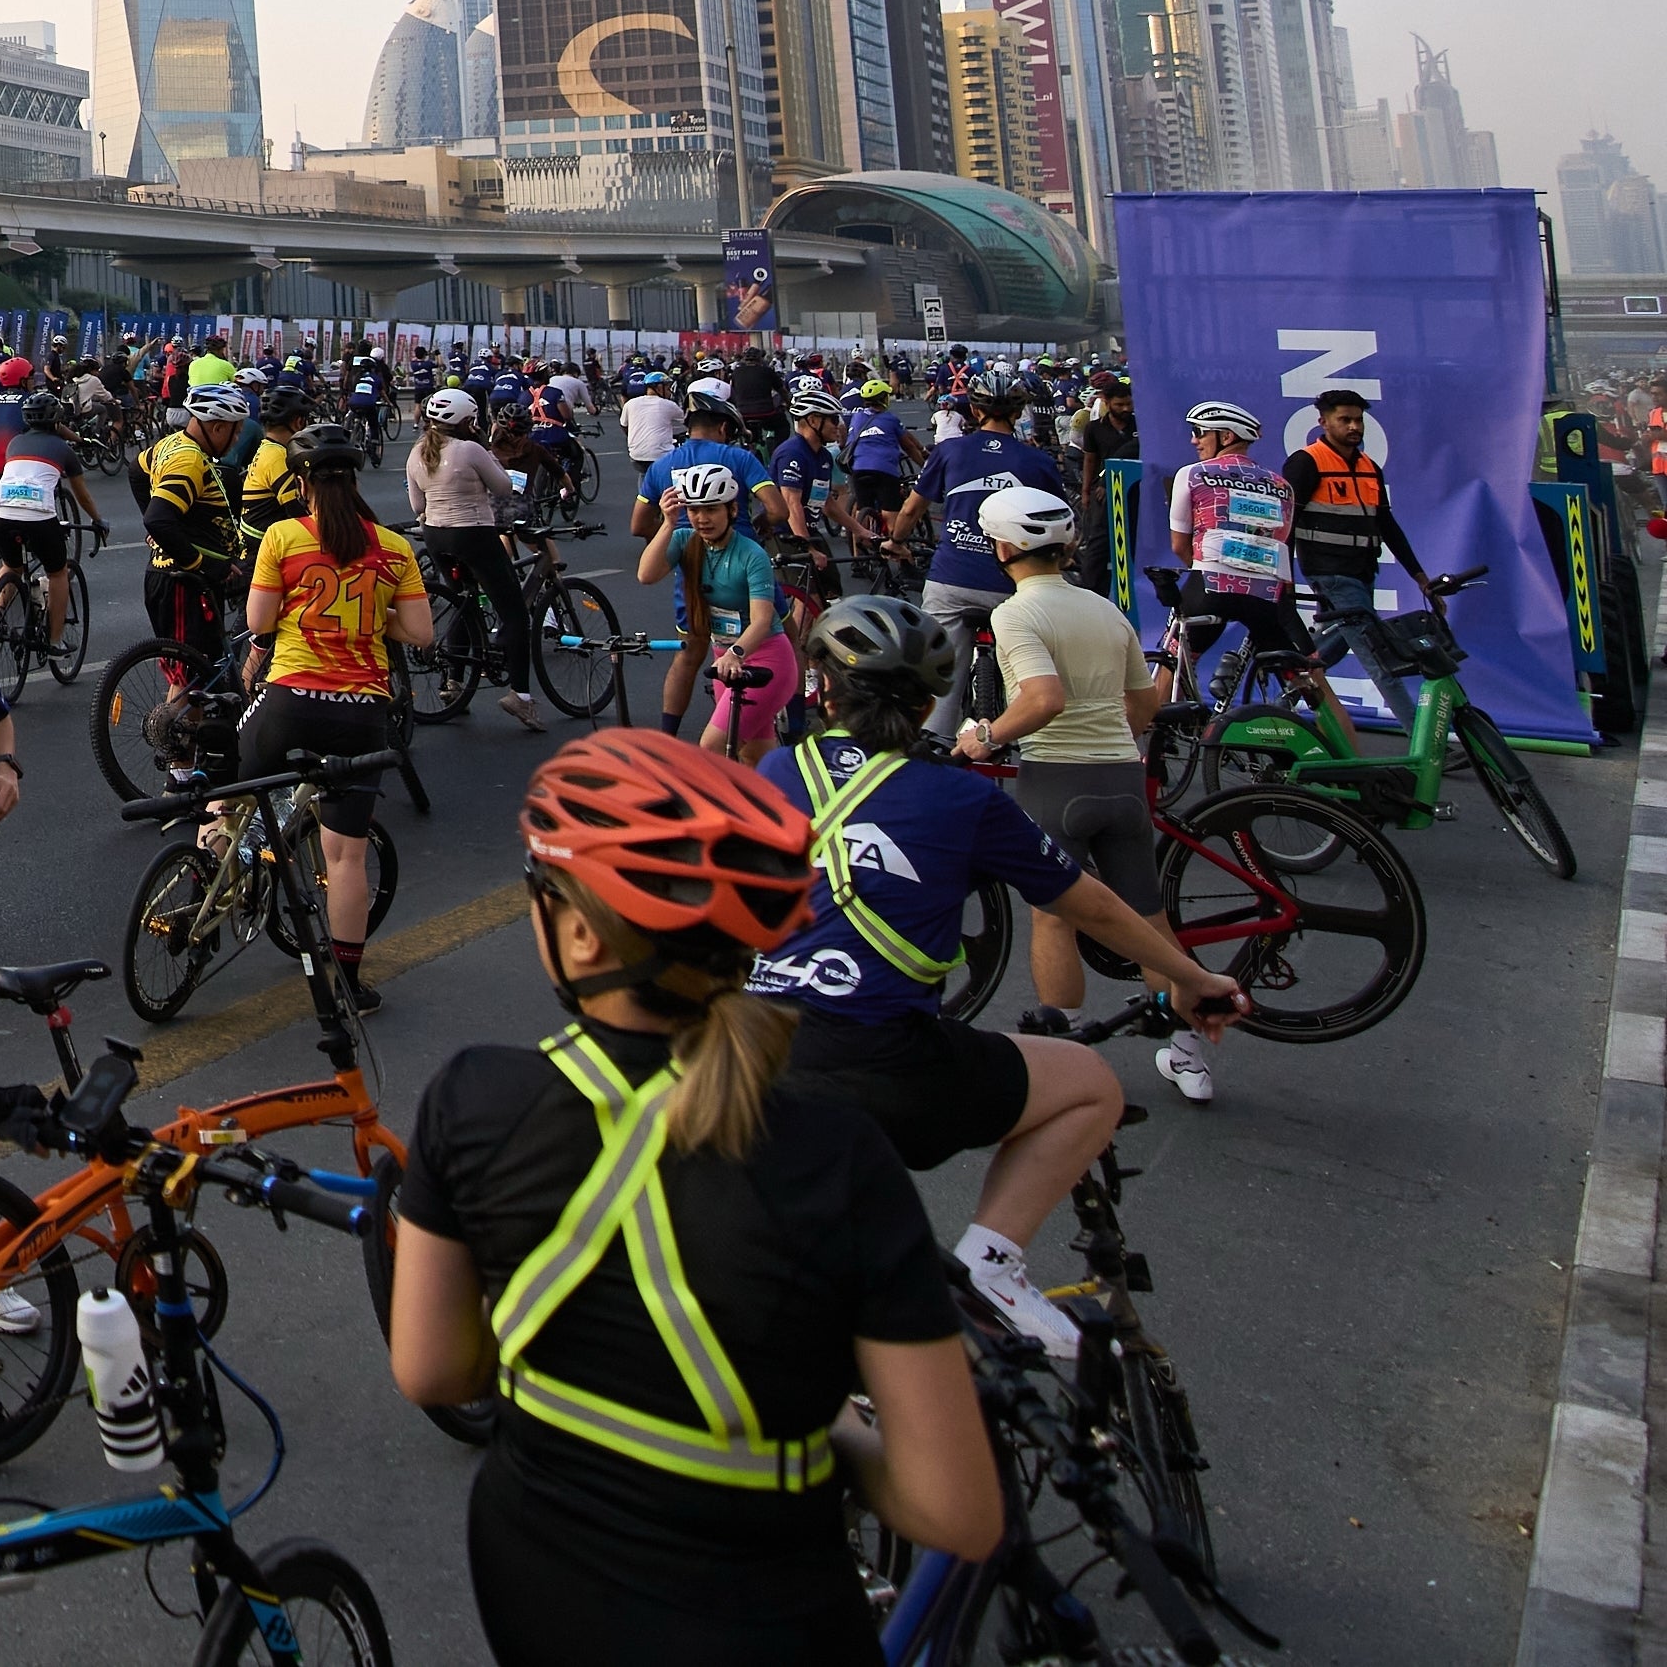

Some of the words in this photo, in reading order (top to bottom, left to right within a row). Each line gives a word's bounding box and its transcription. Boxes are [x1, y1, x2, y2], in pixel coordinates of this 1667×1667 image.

[43, 316, 51, 343] WORLD
[983, 476, 1014, 490] RTA
[951, 531, 984, 544] Jafza
[299, 563, 379, 635] 21
[1436, 690, 1451, 719] BIKE
[1246, 726, 1277, 735] Careem
[1277, 727, 1296, 736] BIKE
[850, 837, 886, 871] TA
